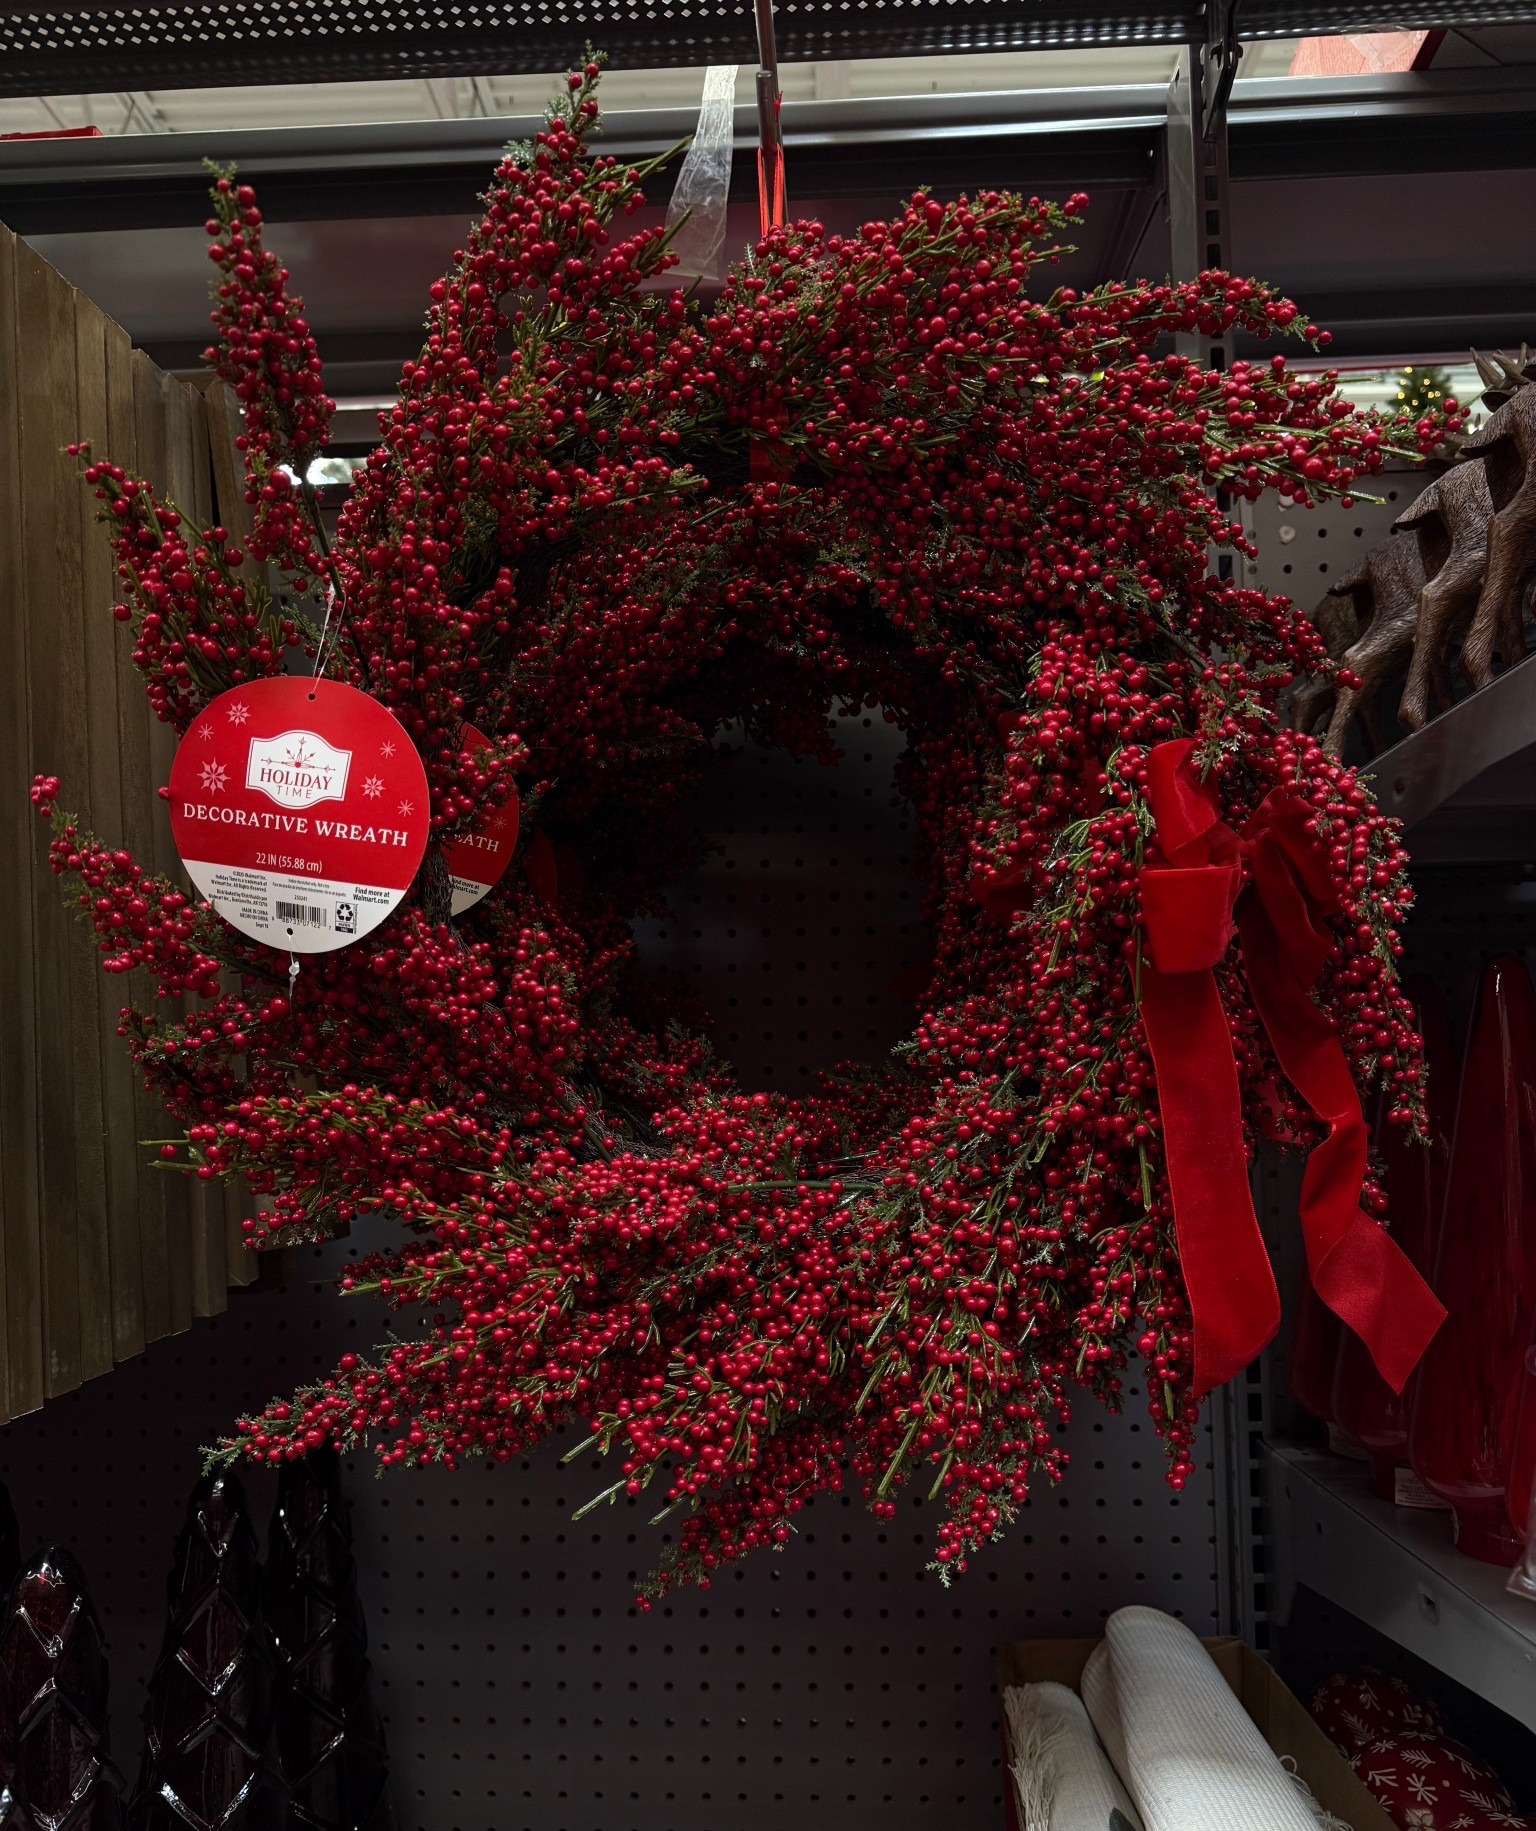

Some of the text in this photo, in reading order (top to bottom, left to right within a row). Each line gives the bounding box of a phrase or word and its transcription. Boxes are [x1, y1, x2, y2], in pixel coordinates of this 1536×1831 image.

[260, 768, 332, 790] HOLIDAY
[277, 785, 312, 799] TIME
[183, 803, 409, 847] DECORATIVE WREATH
[256, 852, 323, 874] 22 IN (55.88 cm)
[353, 893, 389, 905] Walmart.com
[355, 886, 367, 895] Find
[368, 889, 383, 897] more
